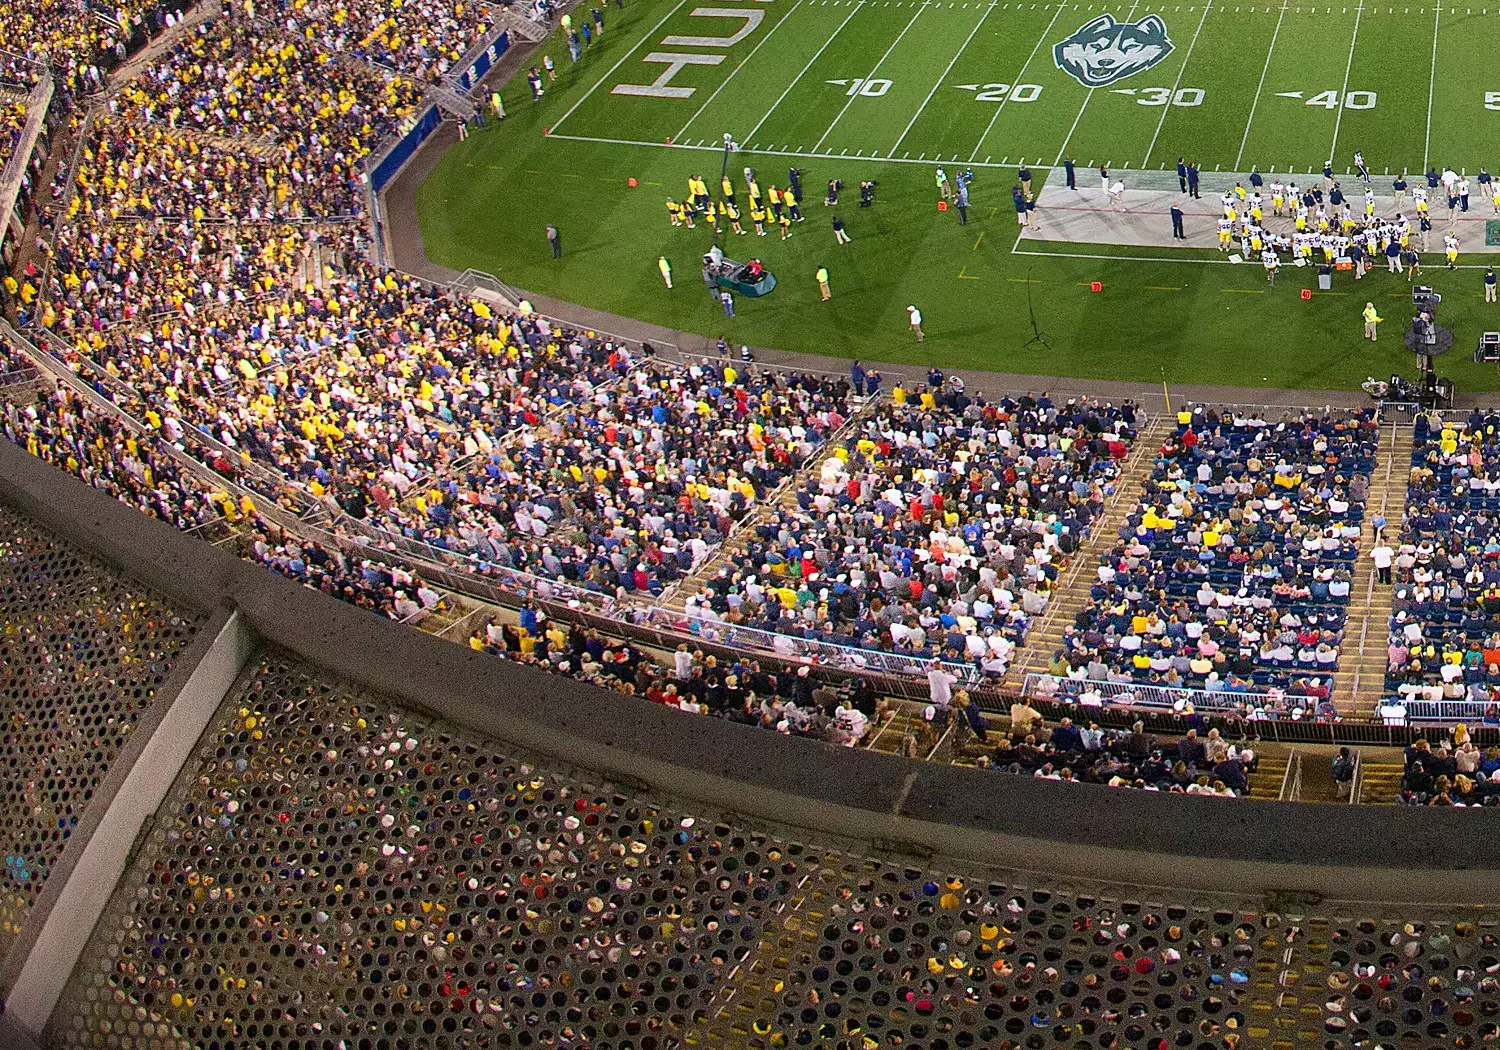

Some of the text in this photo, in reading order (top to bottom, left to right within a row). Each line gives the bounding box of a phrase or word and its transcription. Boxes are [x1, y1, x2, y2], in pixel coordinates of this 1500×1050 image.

[846, 79, 893, 96] 10
[975, 84, 1044, 103] 20
[1137, 88, 1205, 107] 30
[1305, 91, 1377, 110] 40
